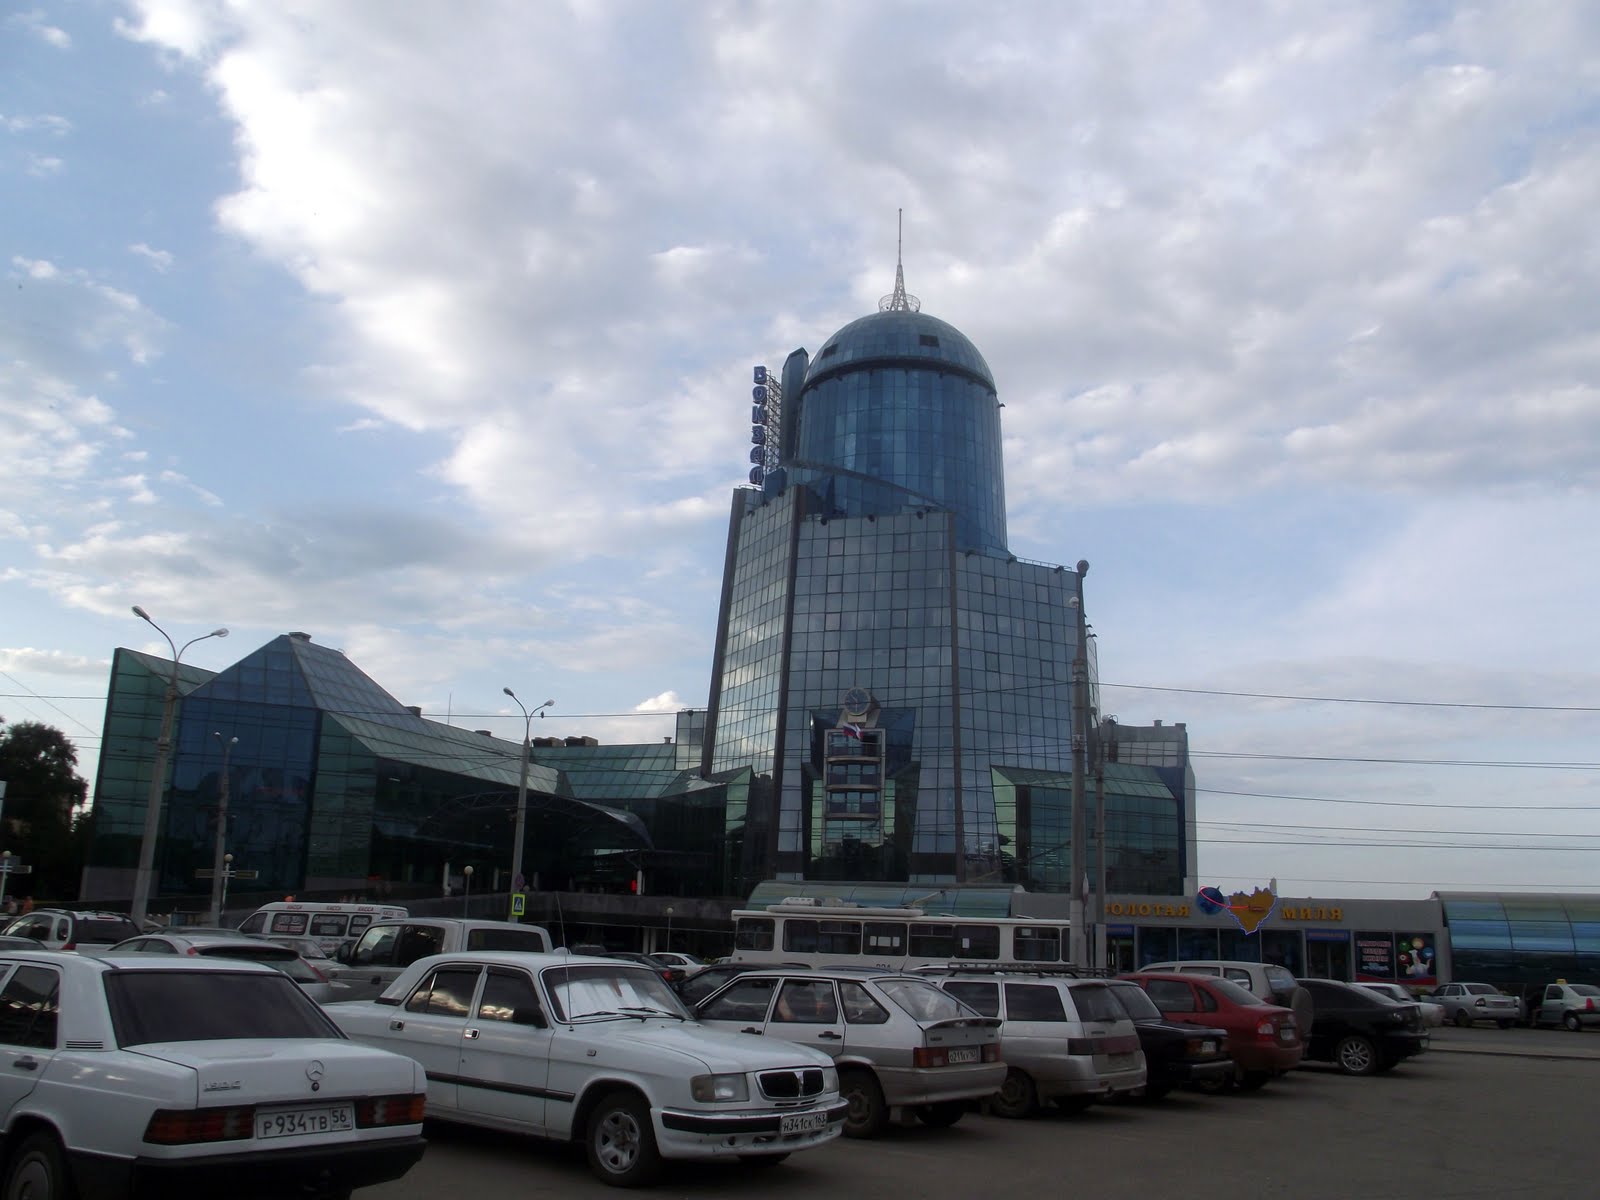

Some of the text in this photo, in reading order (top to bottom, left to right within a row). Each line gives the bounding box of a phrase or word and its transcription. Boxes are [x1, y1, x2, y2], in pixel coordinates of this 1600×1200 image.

[749, 366, 768, 485] ВОКЗАЛ
[1281, 906, 1344, 921] МИЛЯ
[263, 1109, 347, 1136] Р934ТВ 56
[783, 1117, 813, 1132] Н341СК
